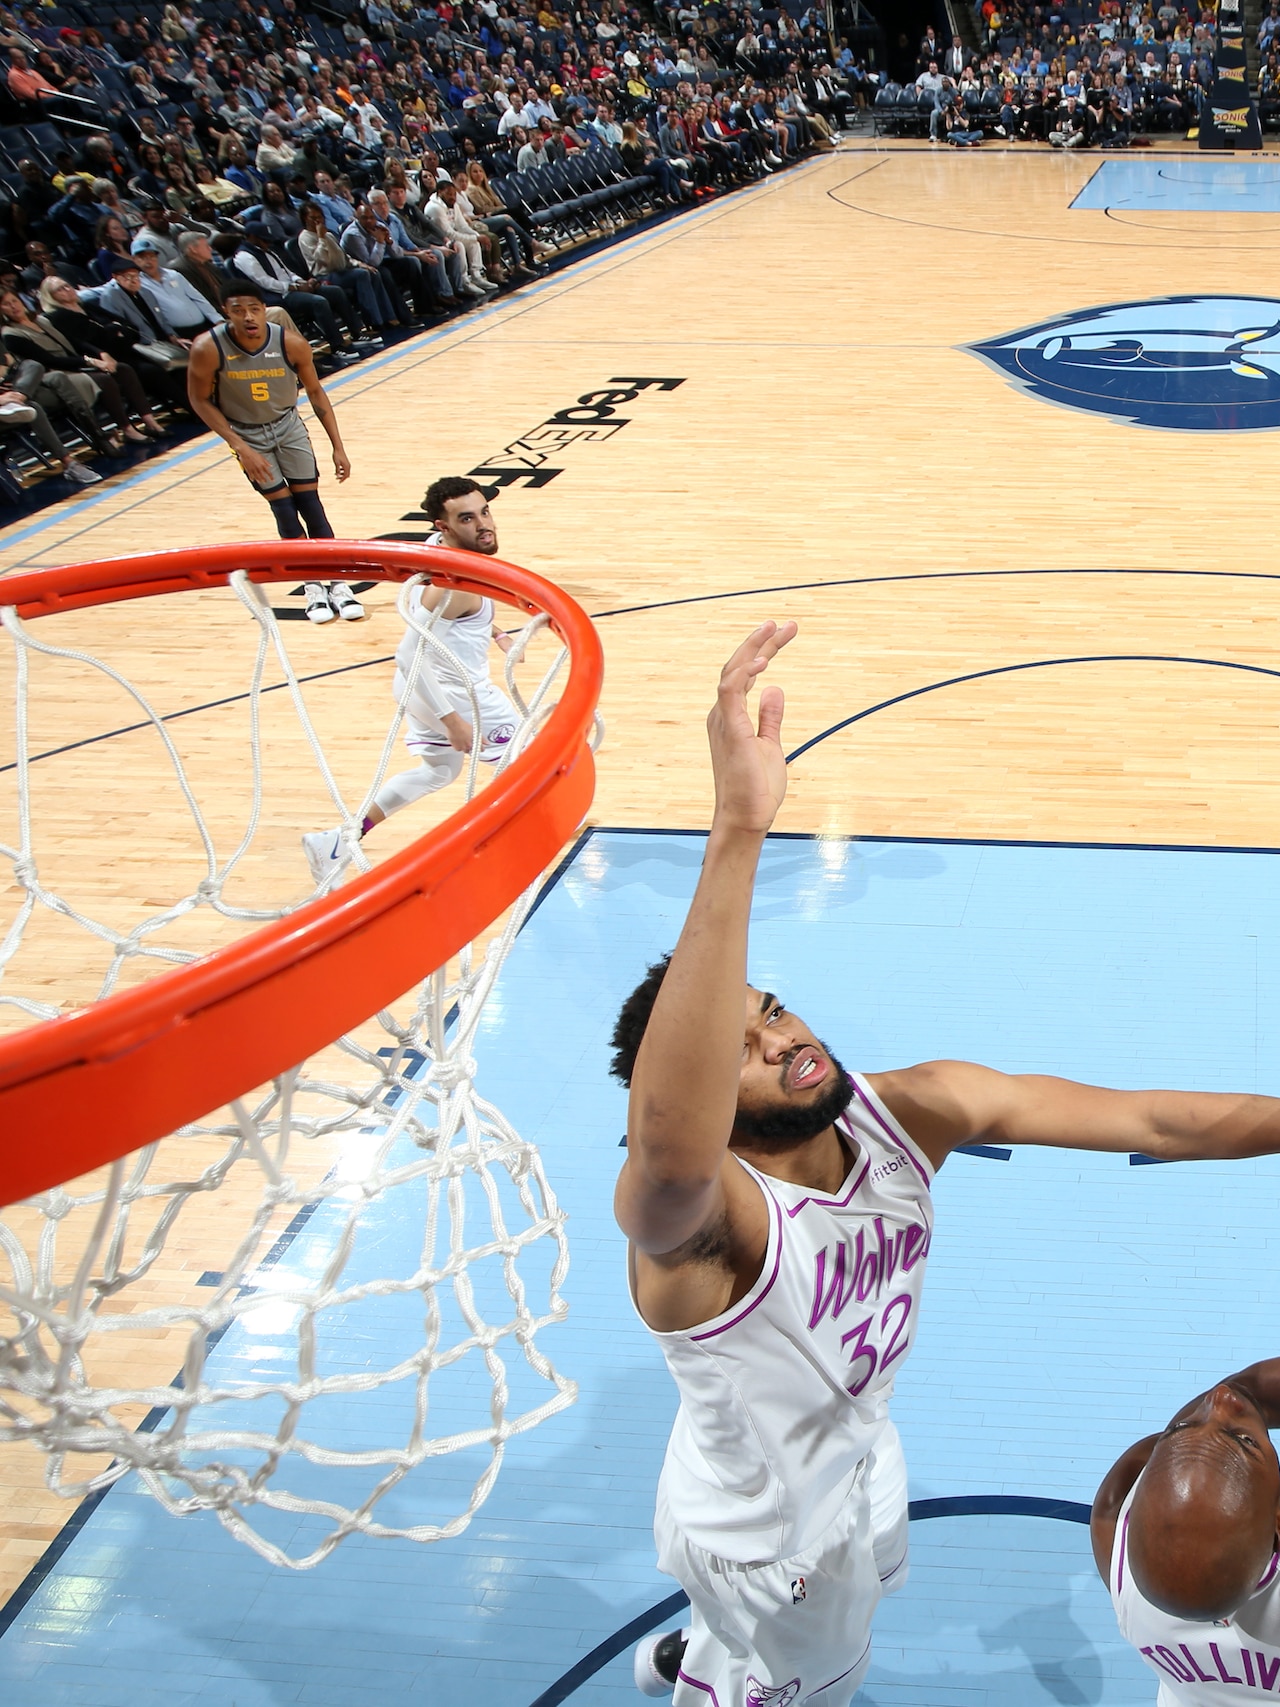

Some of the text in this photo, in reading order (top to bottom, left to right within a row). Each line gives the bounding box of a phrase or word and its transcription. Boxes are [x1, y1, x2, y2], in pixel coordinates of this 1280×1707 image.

[1215, 113, 1247, 121] SONIC
[227, 367, 286, 380] MEMPHIS
[250, 382, 270, 402] 5
[874, 1154, 909, 1185] fitbit
[840, 1293, 912, 1397] 32
